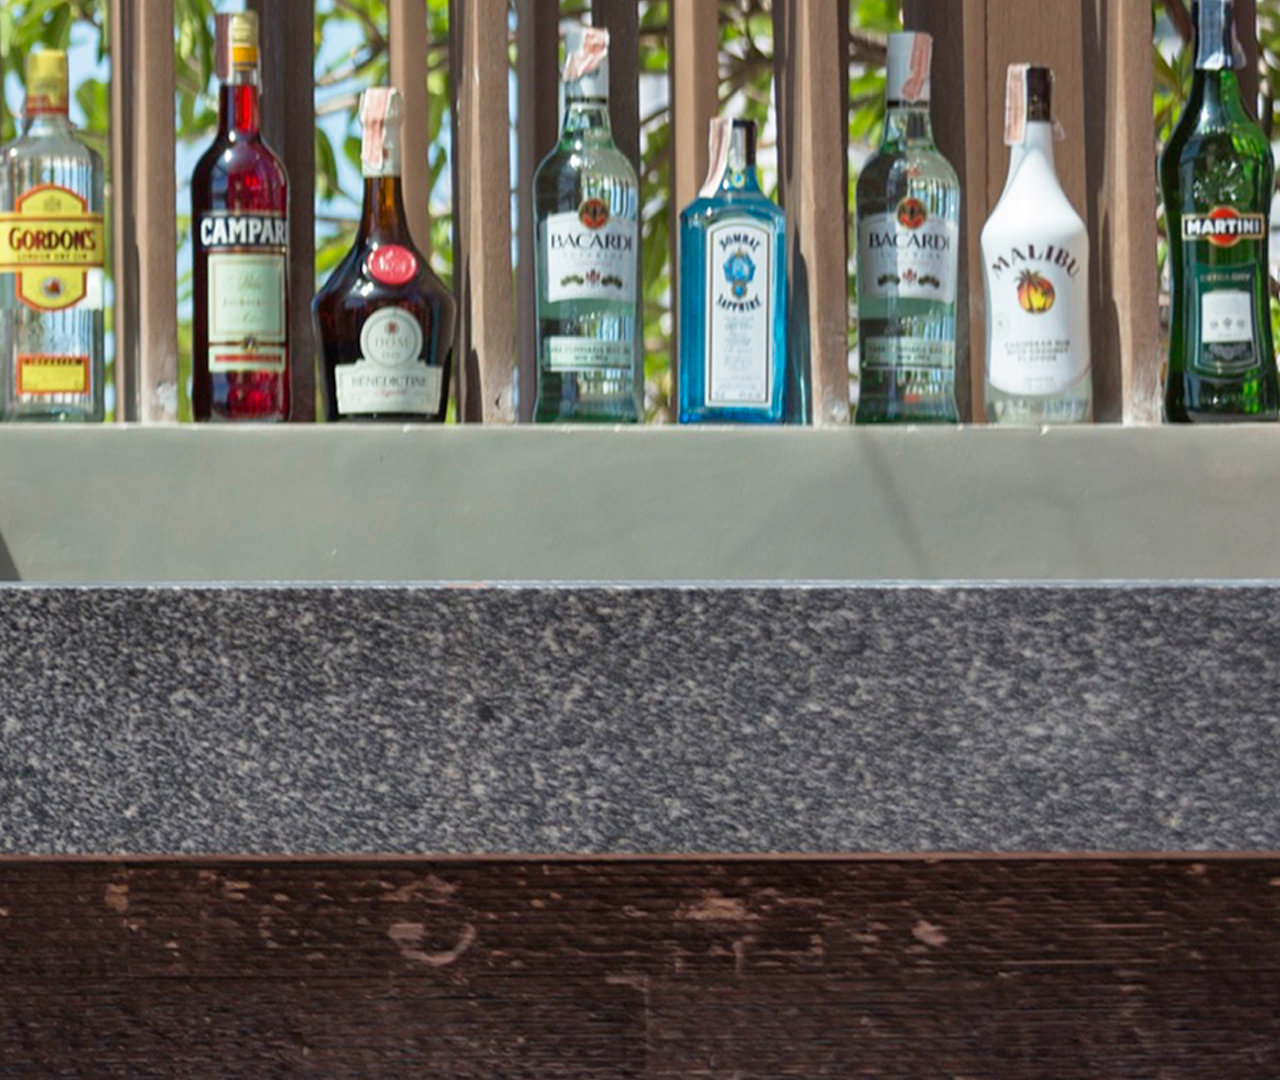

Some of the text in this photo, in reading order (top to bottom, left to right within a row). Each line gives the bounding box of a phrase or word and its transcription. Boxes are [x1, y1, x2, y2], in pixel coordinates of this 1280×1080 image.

[1186, 218, 1259, 235] MARTINI
[8, 226, 96, 251] GORDON'S
[551, 234, 633, 252] BACARDI
[719, 233, 760, 251] BOMBAY
[869, 233, 950, 251] BACARDI
[992, 244, 1080, 279] MALIBU
[717, 294, 762, 312] SAPPHIRE
